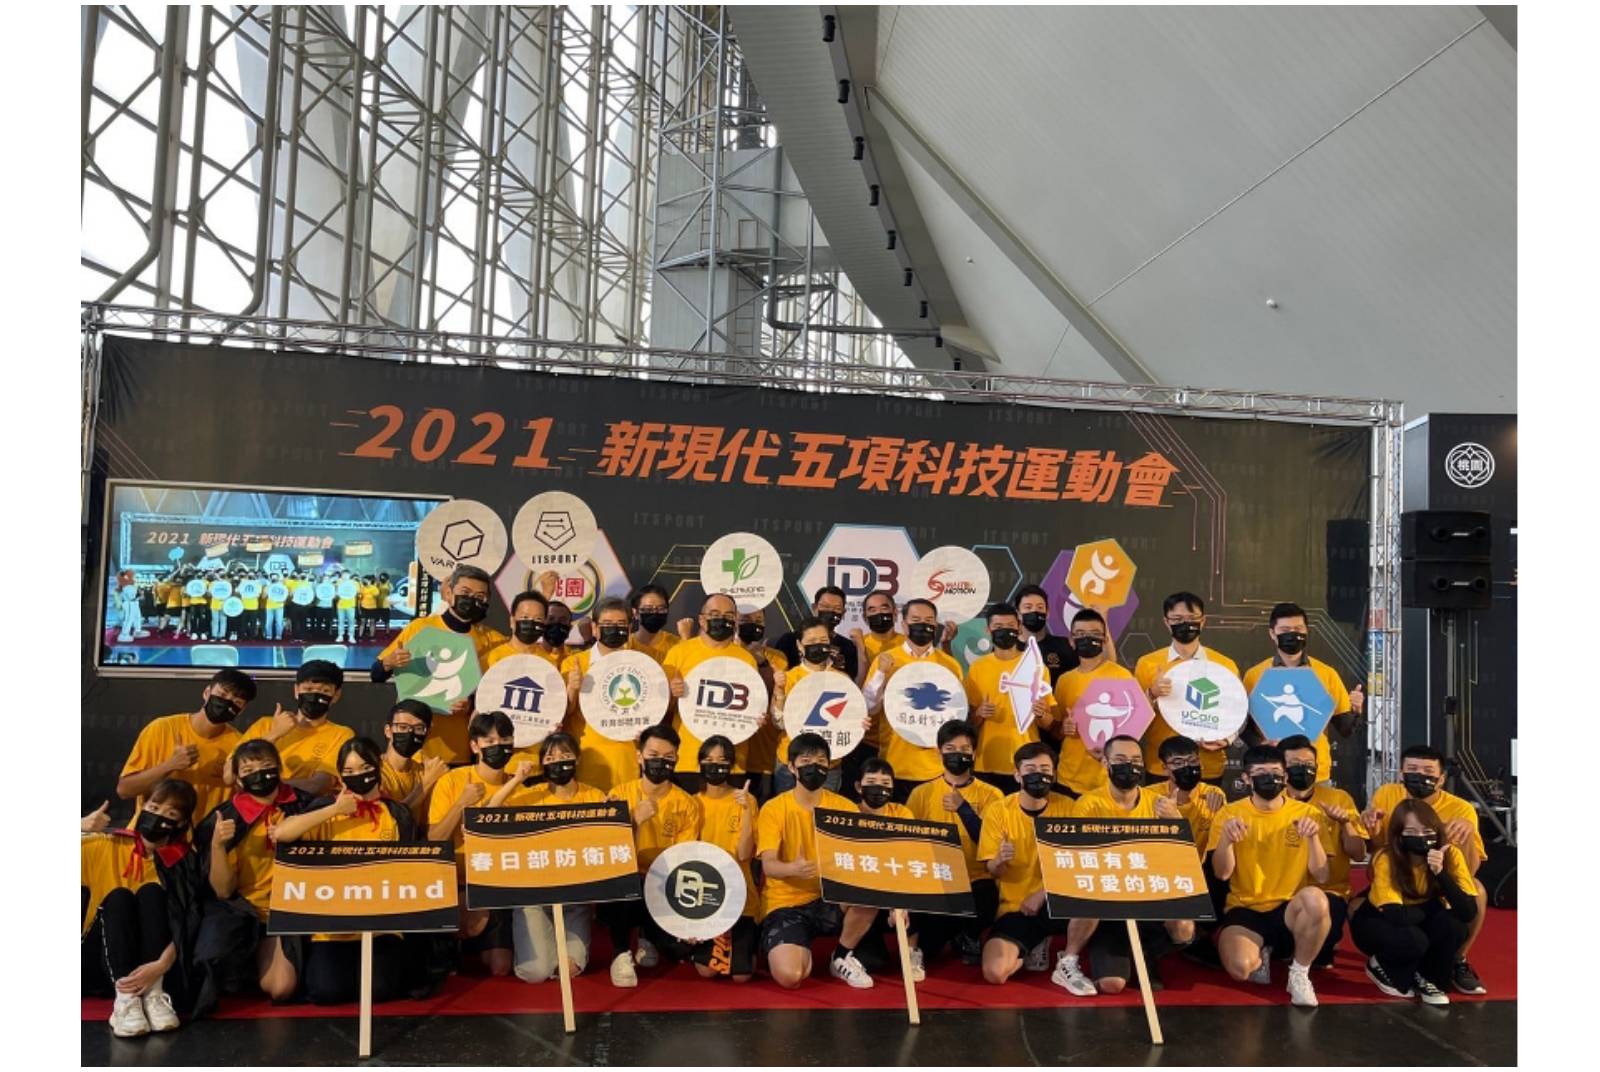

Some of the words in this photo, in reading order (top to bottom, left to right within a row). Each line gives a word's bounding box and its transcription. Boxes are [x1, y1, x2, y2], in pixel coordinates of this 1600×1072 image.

[355, 405, 554, 469] 2021
[598, 420, 1180, 508] 新現代五項科技運動會
[532, 554, 578, 564] ITSPORT
[476, 813, 510, 824] 2021
[824, 815, 853, 827] 2021
[1046, 824, 1076, 834] 2021
[288, 847, 325, 855] 2021
[471, 844, 633, 872] 春日部防衛隊
[834, 852, 953, 881] 暗夜十字路
[1054, 852, 1148, 869] 前面有隻
[283, 880, 444, 900] Nomind
[1074, 874, 1194, 893] 可愛的狗勾
